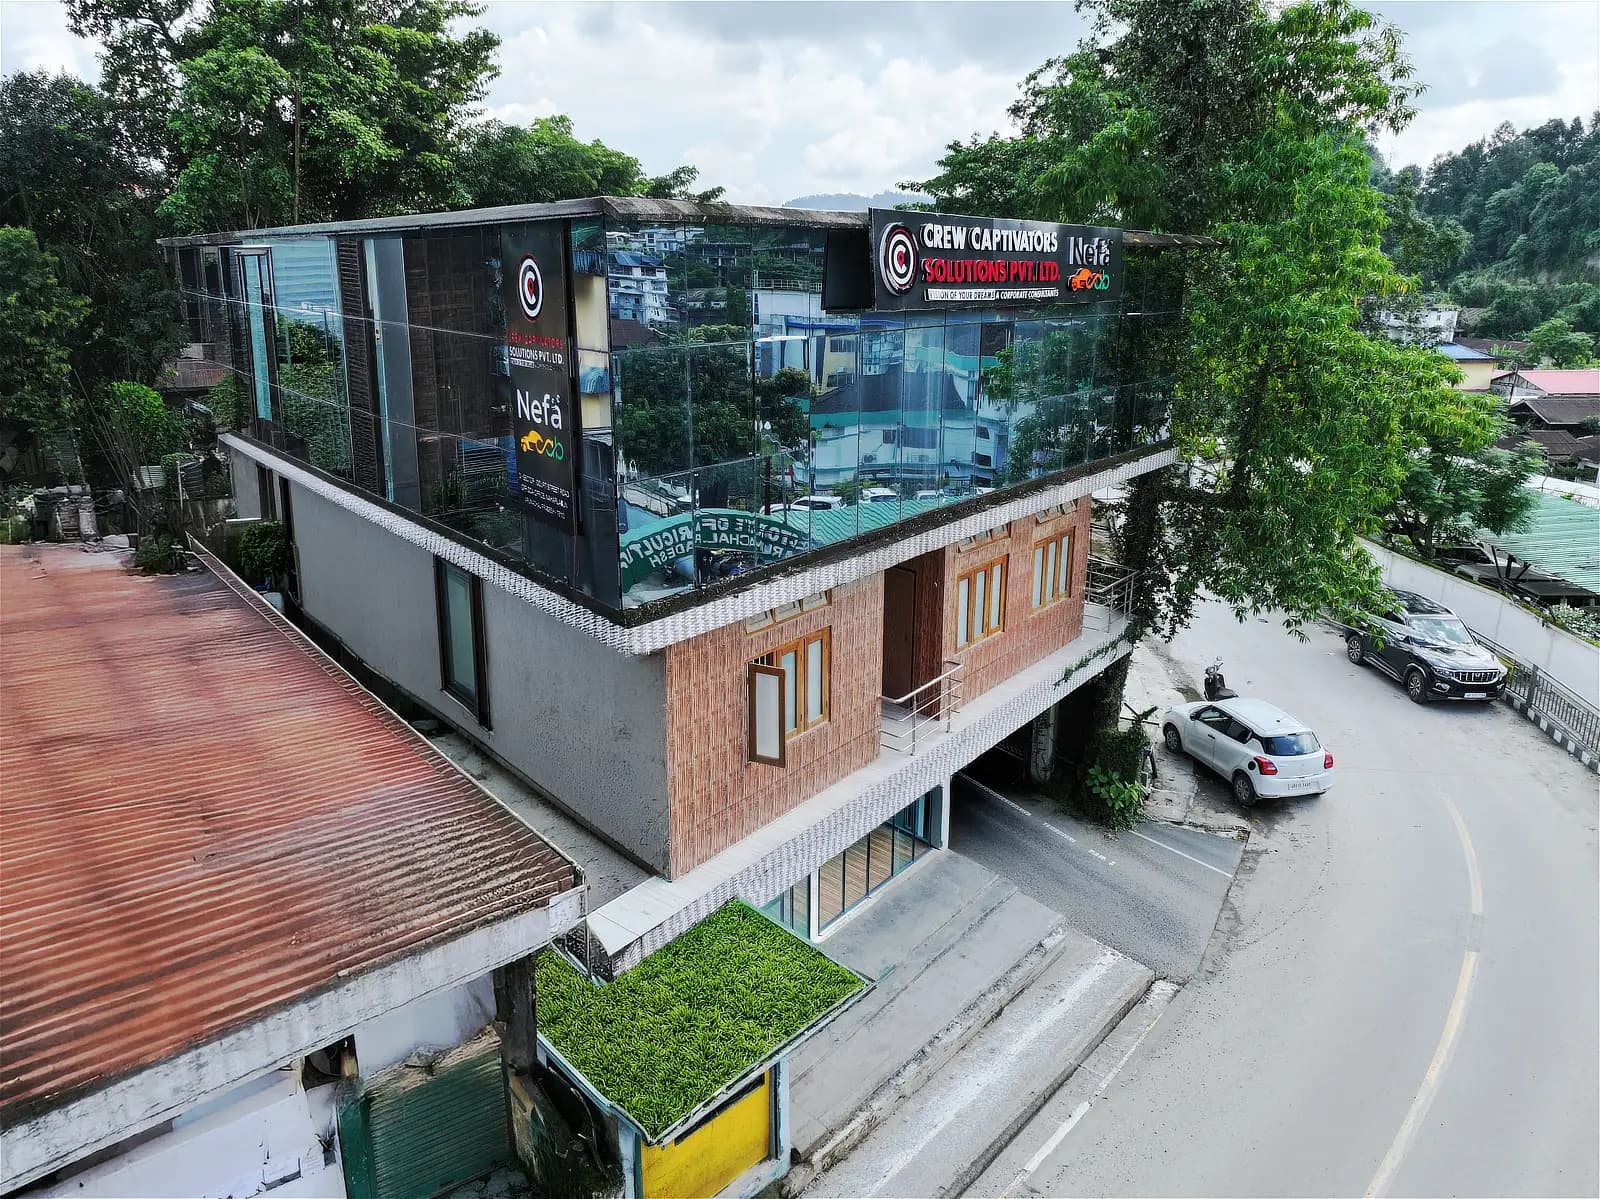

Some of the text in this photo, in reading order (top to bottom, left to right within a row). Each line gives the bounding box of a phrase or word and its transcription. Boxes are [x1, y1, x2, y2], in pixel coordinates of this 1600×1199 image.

[922, 223, 1058, 253] CREW CAPTIVATORS
[923, 257, 1061, 283] SOLUTIONS PVT. LTD.
[949, 290, 958, 300] OF
[959, 290, 973, 300] YOUR
[509, 346, 539, 361] SOLUTIONS
[539, 350, 552, 363] PVT.
